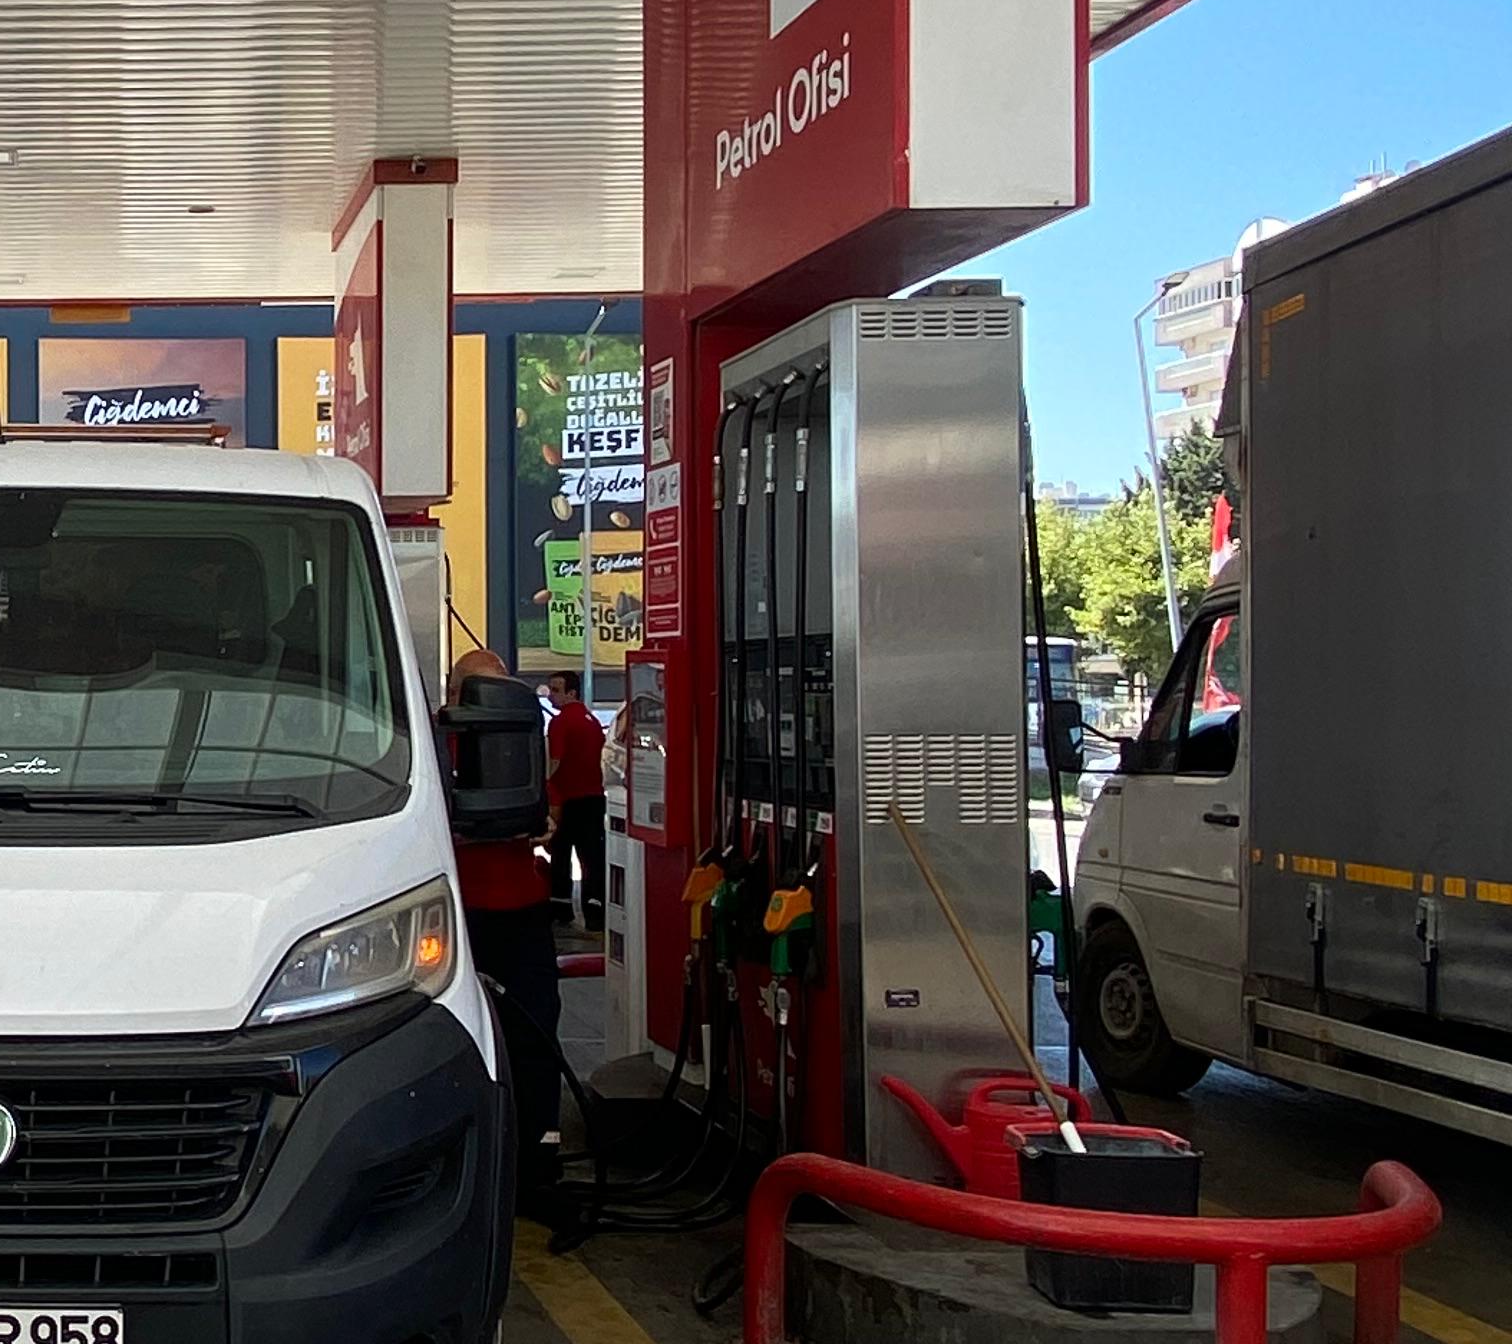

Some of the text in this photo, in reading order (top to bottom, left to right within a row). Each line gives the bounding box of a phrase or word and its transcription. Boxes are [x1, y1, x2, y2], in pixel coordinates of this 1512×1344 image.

[715, 31, 851, 191] Petrol Ofisi
[598, 625, 641, 643] DEM
